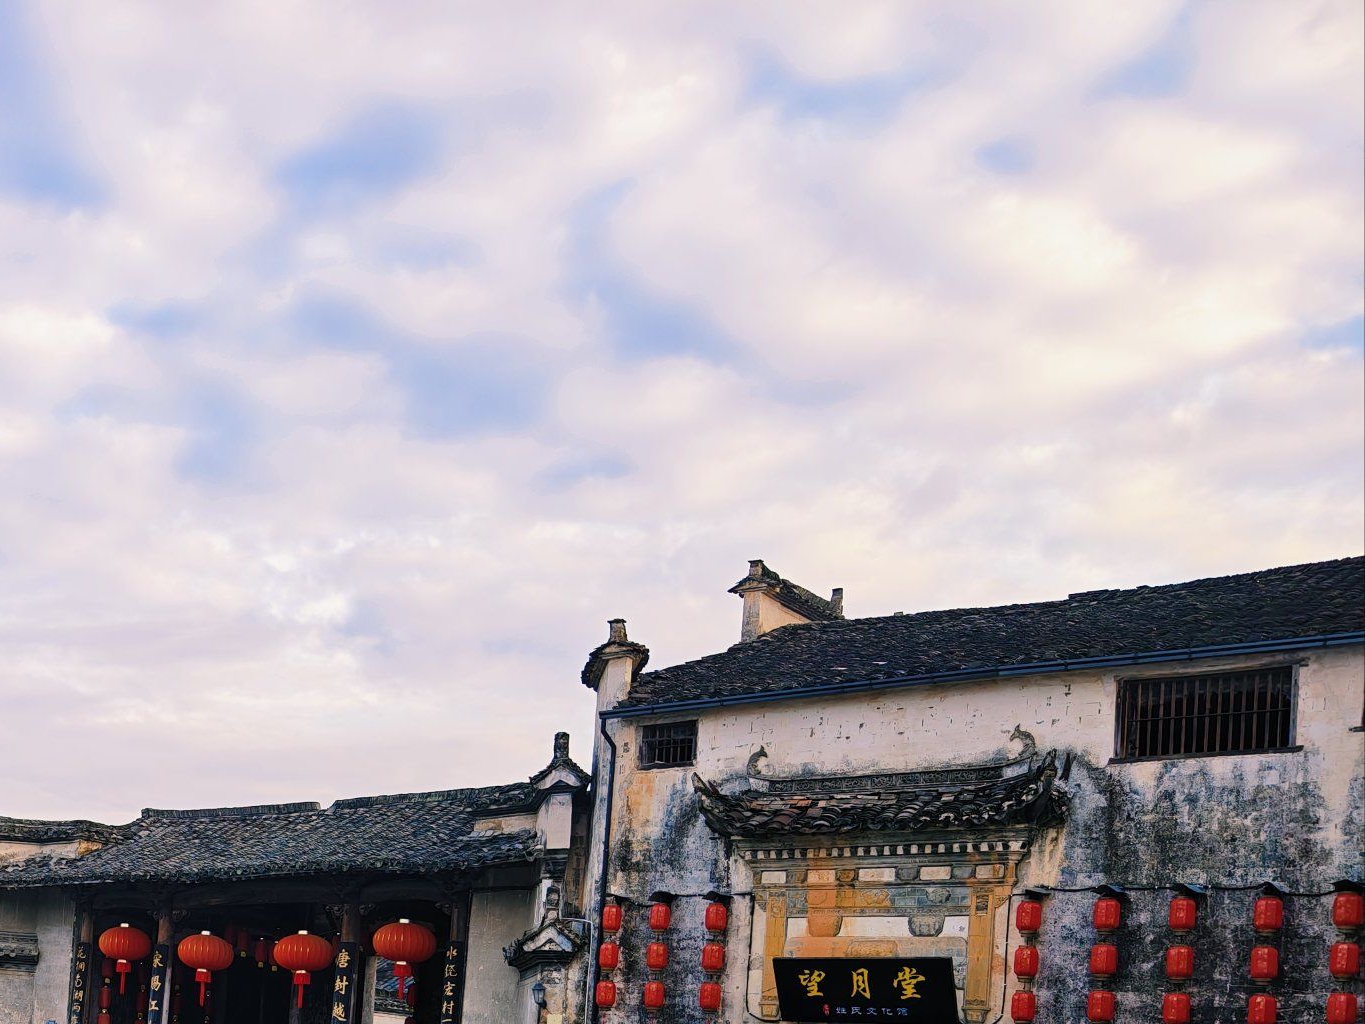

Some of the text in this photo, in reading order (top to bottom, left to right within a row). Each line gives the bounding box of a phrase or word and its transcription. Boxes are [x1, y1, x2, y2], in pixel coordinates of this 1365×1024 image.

[798, 967, 926, 1000] 望月堂
[836, 1006, 908, 1016] 姓氏文化馆
